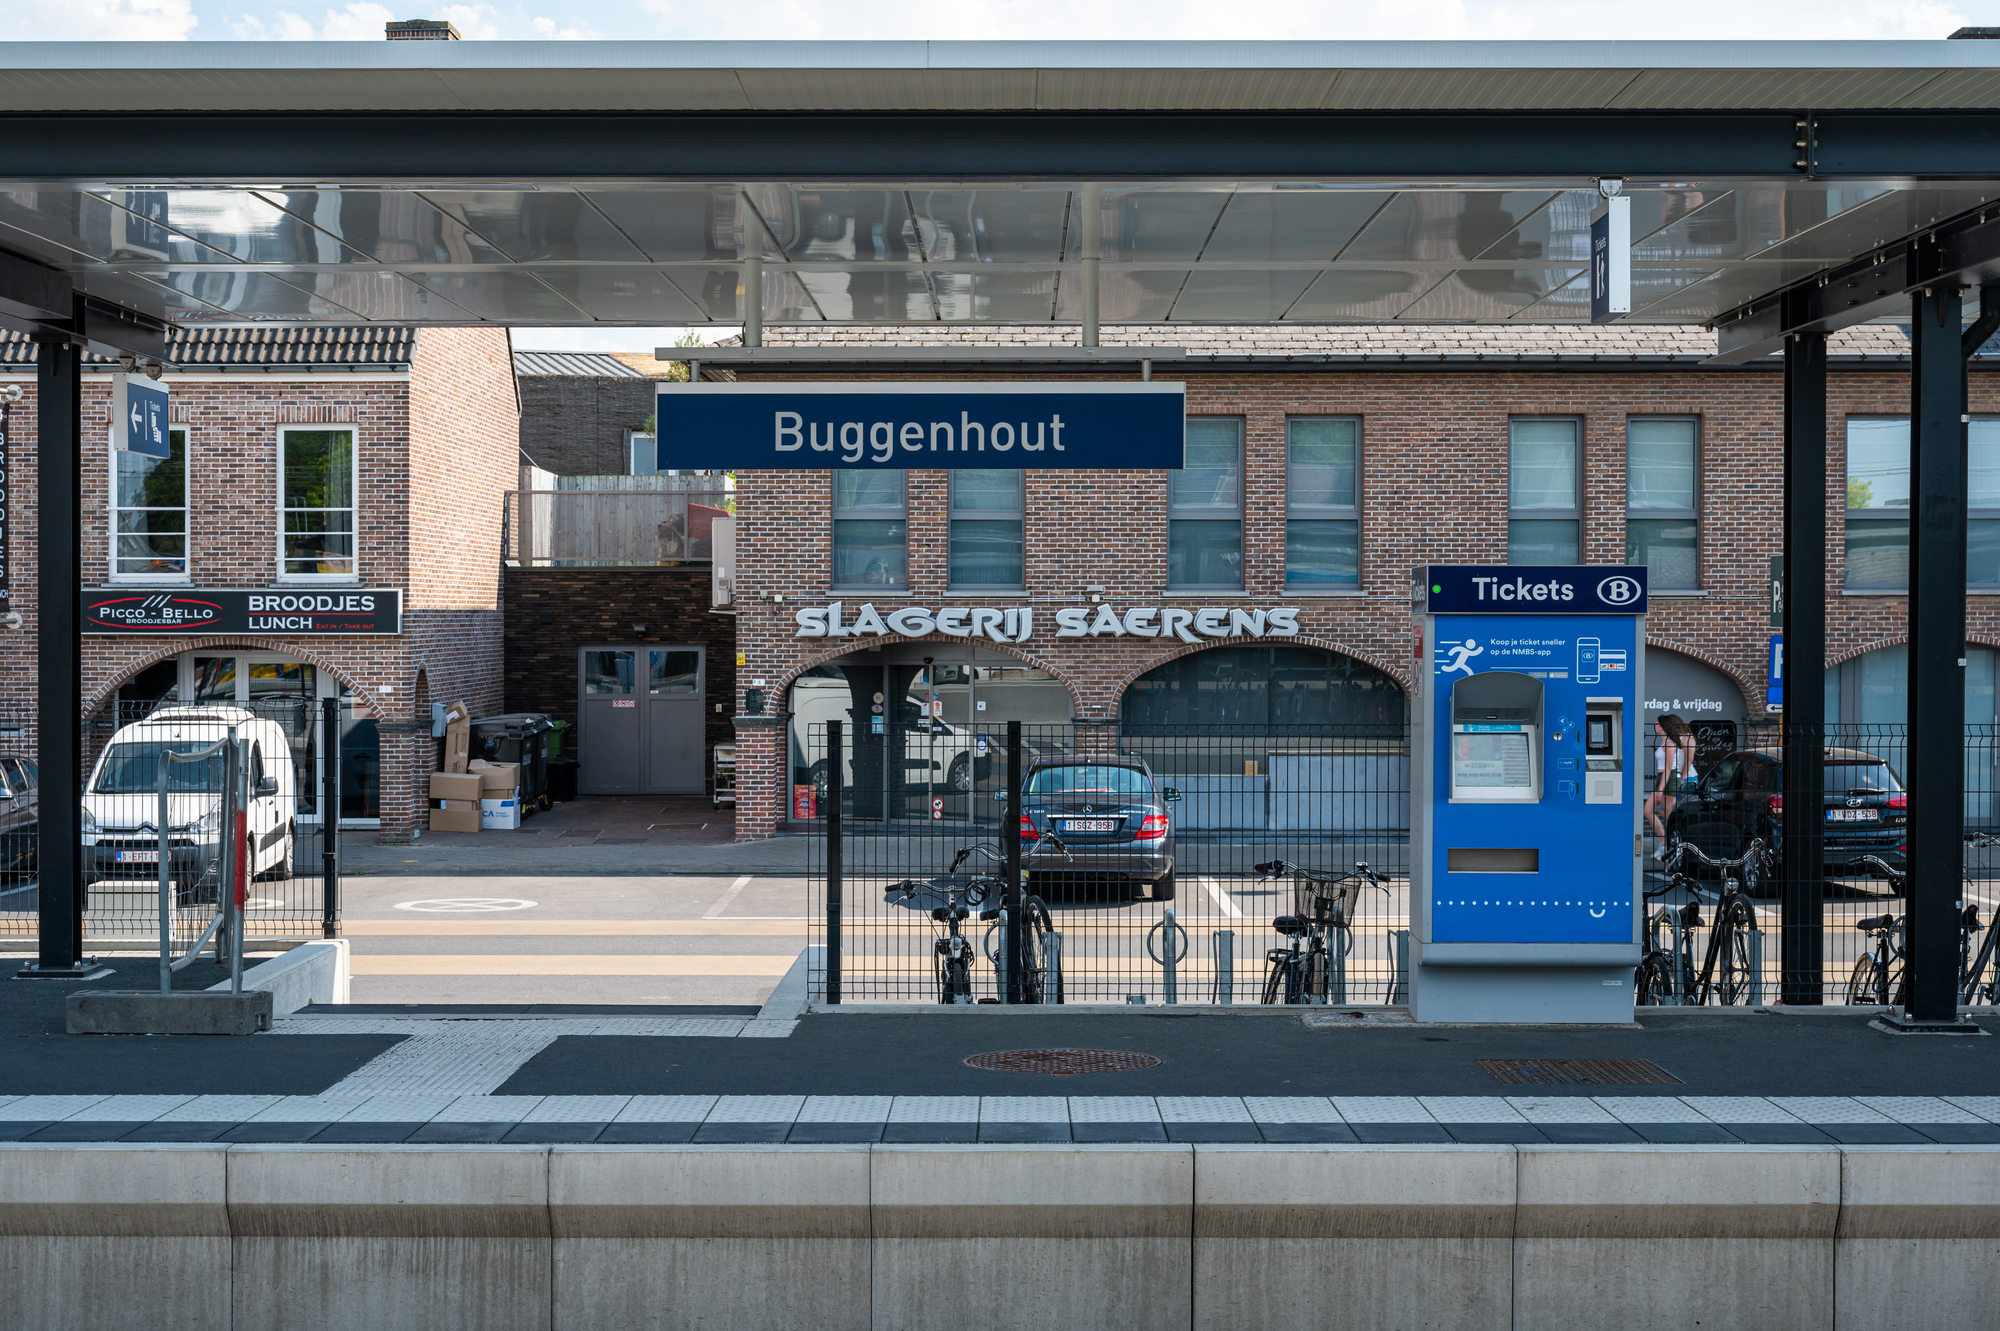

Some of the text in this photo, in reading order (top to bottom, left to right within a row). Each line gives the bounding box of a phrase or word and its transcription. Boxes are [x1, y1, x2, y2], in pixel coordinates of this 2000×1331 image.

[774, 411, 1066, 463] Buggenhout
[1472, 577, 1574, 601] Tickets
[248, 595, 375, 611] BROODJES
[248, 616, 313, 629] LUNCH
[795, 601, 1300, 644] SLAGERIJ SAERENS
[1490, 638, 1510, 646] Koop
[1511, 638, 1518, 647] je
[1512, 648, 1552, 656] NMBS-app
[1672, 699, 1681, 710] &
[1683, 698, 1722, 712] vrijdag
